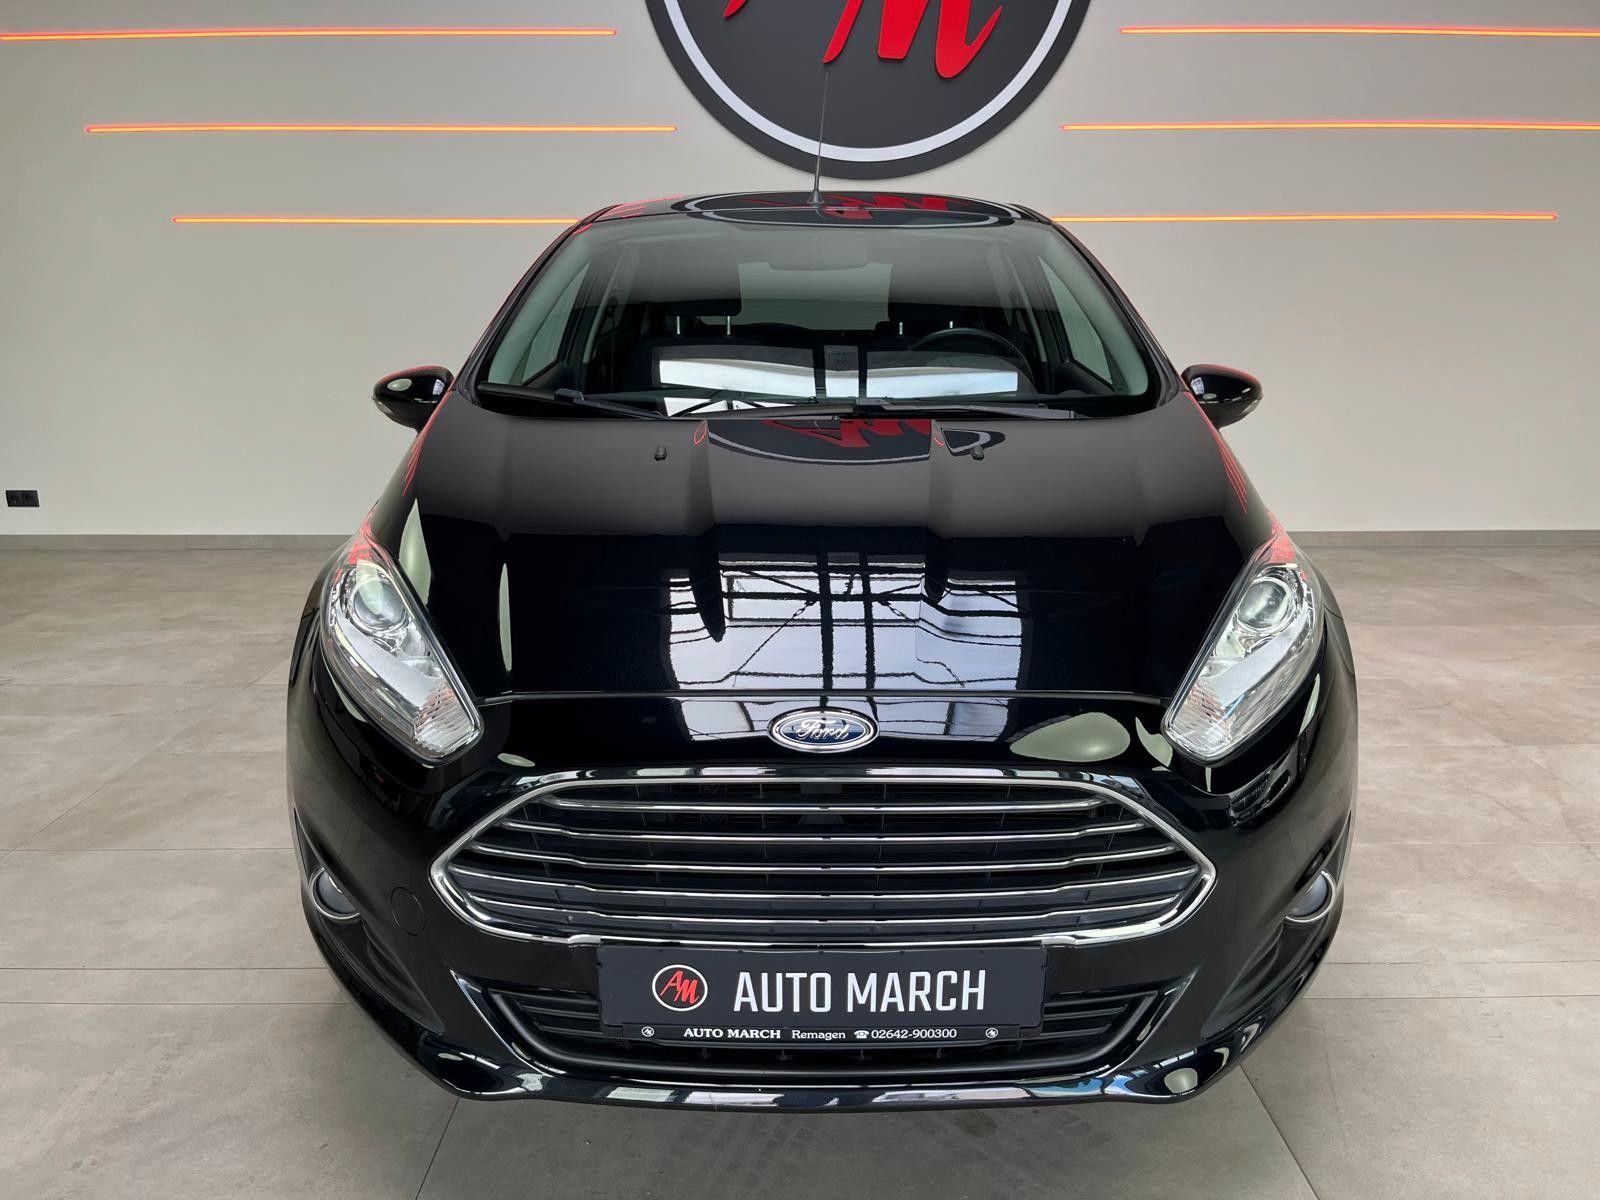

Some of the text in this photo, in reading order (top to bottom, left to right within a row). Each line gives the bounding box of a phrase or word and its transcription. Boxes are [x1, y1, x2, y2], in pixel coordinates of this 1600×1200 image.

[795, 719, 850, 740] Ford
[733, 969, 986, 1013] AUTO MARCH
[683, 1027, 958, 1041] AUTO MARCH Remagen 02642-900300
